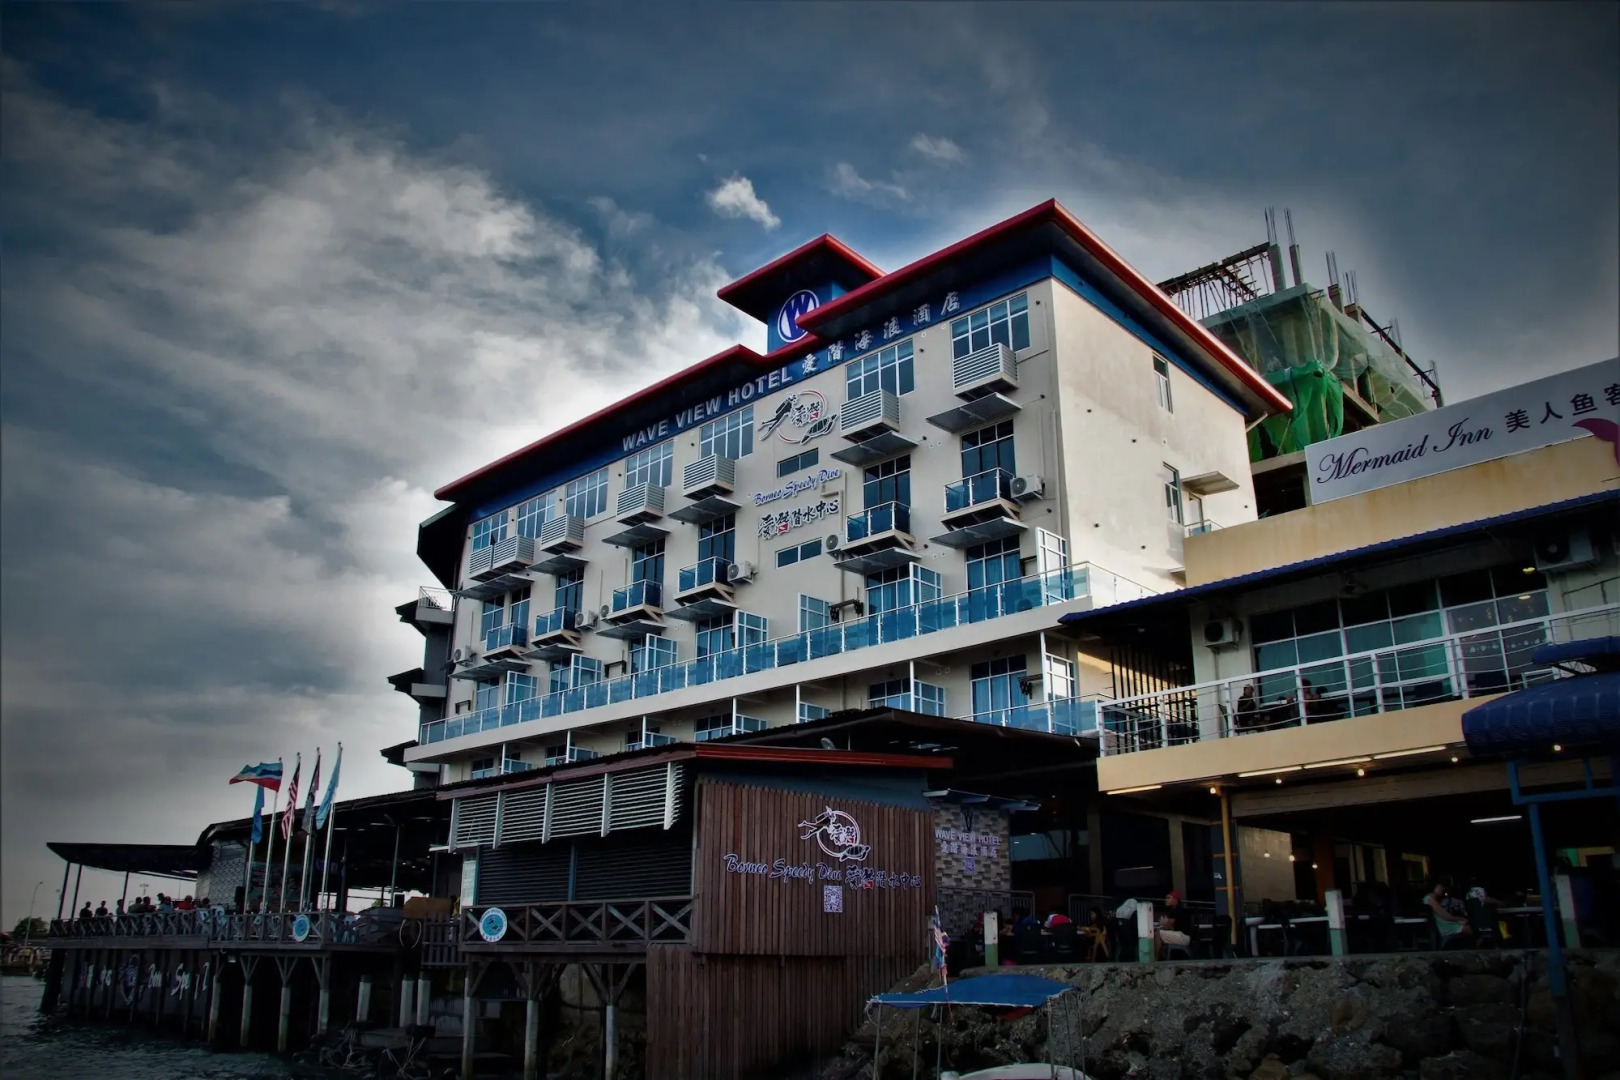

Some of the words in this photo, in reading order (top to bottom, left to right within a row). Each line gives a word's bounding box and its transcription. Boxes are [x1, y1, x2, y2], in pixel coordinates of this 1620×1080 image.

[622, 418, 668, 452] WAVE
[675, 395, 723, 428] VIEW
[728, 366, 792, 406] HOTEL
[1317, 434, 1428, 484] Mermaid
[1433, 417, 1494, 453] Inn
[754, 488, 782, 506] Borneo
[782, 474, 817, 499] Speedy
[818, 467, 841, 484] Dive
[934, 828, 956, 840] WAVE
[957, 832, 976, 843] VIEW
[978, 834, 1000, 845] HOTEL
[723, 853, 769, 874] Borneo
[769, 857, 816, 885] Speedy
[816, 861, 843, 881] Dive
